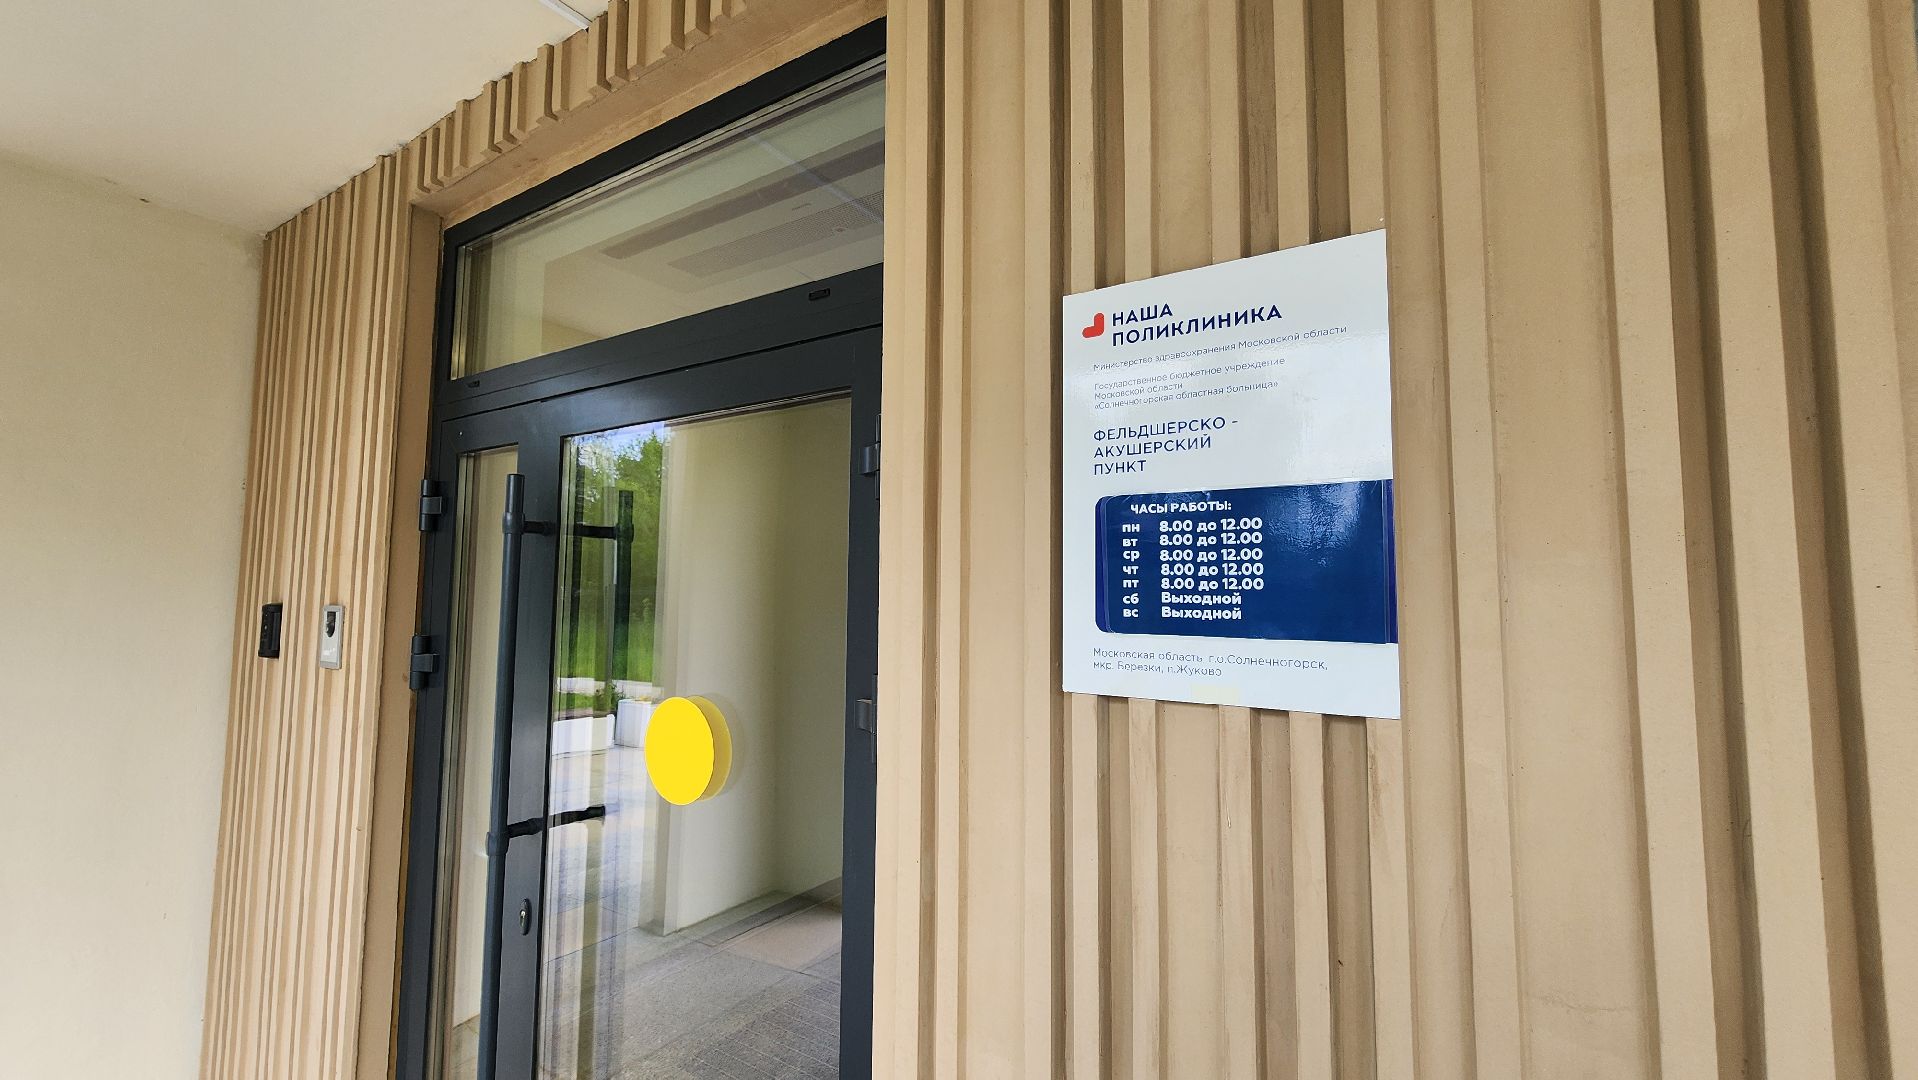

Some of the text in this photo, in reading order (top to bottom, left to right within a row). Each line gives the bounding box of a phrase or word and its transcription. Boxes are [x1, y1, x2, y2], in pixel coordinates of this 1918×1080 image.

[1112, 303, 1173, 327] НАША
[1112, 304, 1282, 347] ПОЛИКЛИНИКА
[1093, 355, 1153, 371] Министерство
[1238, 332, 1300, 349] Московской
[1303, 325, 1347, 339] области
[1094, 357, 1286, 391] Государственное бюджетное учреждение
[1094, 382, 1183, 400] Московской области
[1175, 385, 1224, 400] областная
[1226, 380, 1279, 394] больница»
[1093, 416, 1226, 442] ФЕЛЬДШЕРСКО
[1093, 434, 1211, 459] АКУШЕРСКИЙ
[1094, 460, 1147, 476] ПУНКТ
[1130, 500, 1232, 514] ЧАСЫ РАБОТЫ:
[1159, 520, 1193, 532] 8.00
[1196, 521, 1217, 533] до
[1220, 517, 1263, 531] 12.00
[1159, 533, 1193, 546] 8.00
[1196, 535, 1217, 547] до
[1220, 531, 1263, 545] 12.00
[1122, 548, 1263, 562] ср 8.00 до 12.00
[1122, 563, 1264, 577] чт 8.00 до 12.00
[1122, 577, 1264, 592] пт 8.00 до 12.00
[1122, 592, 1242, 606] сб Выходной
[1122, 606, 1242, 620] вс Выходной
[1093, 647, 1155, 660] Московская
